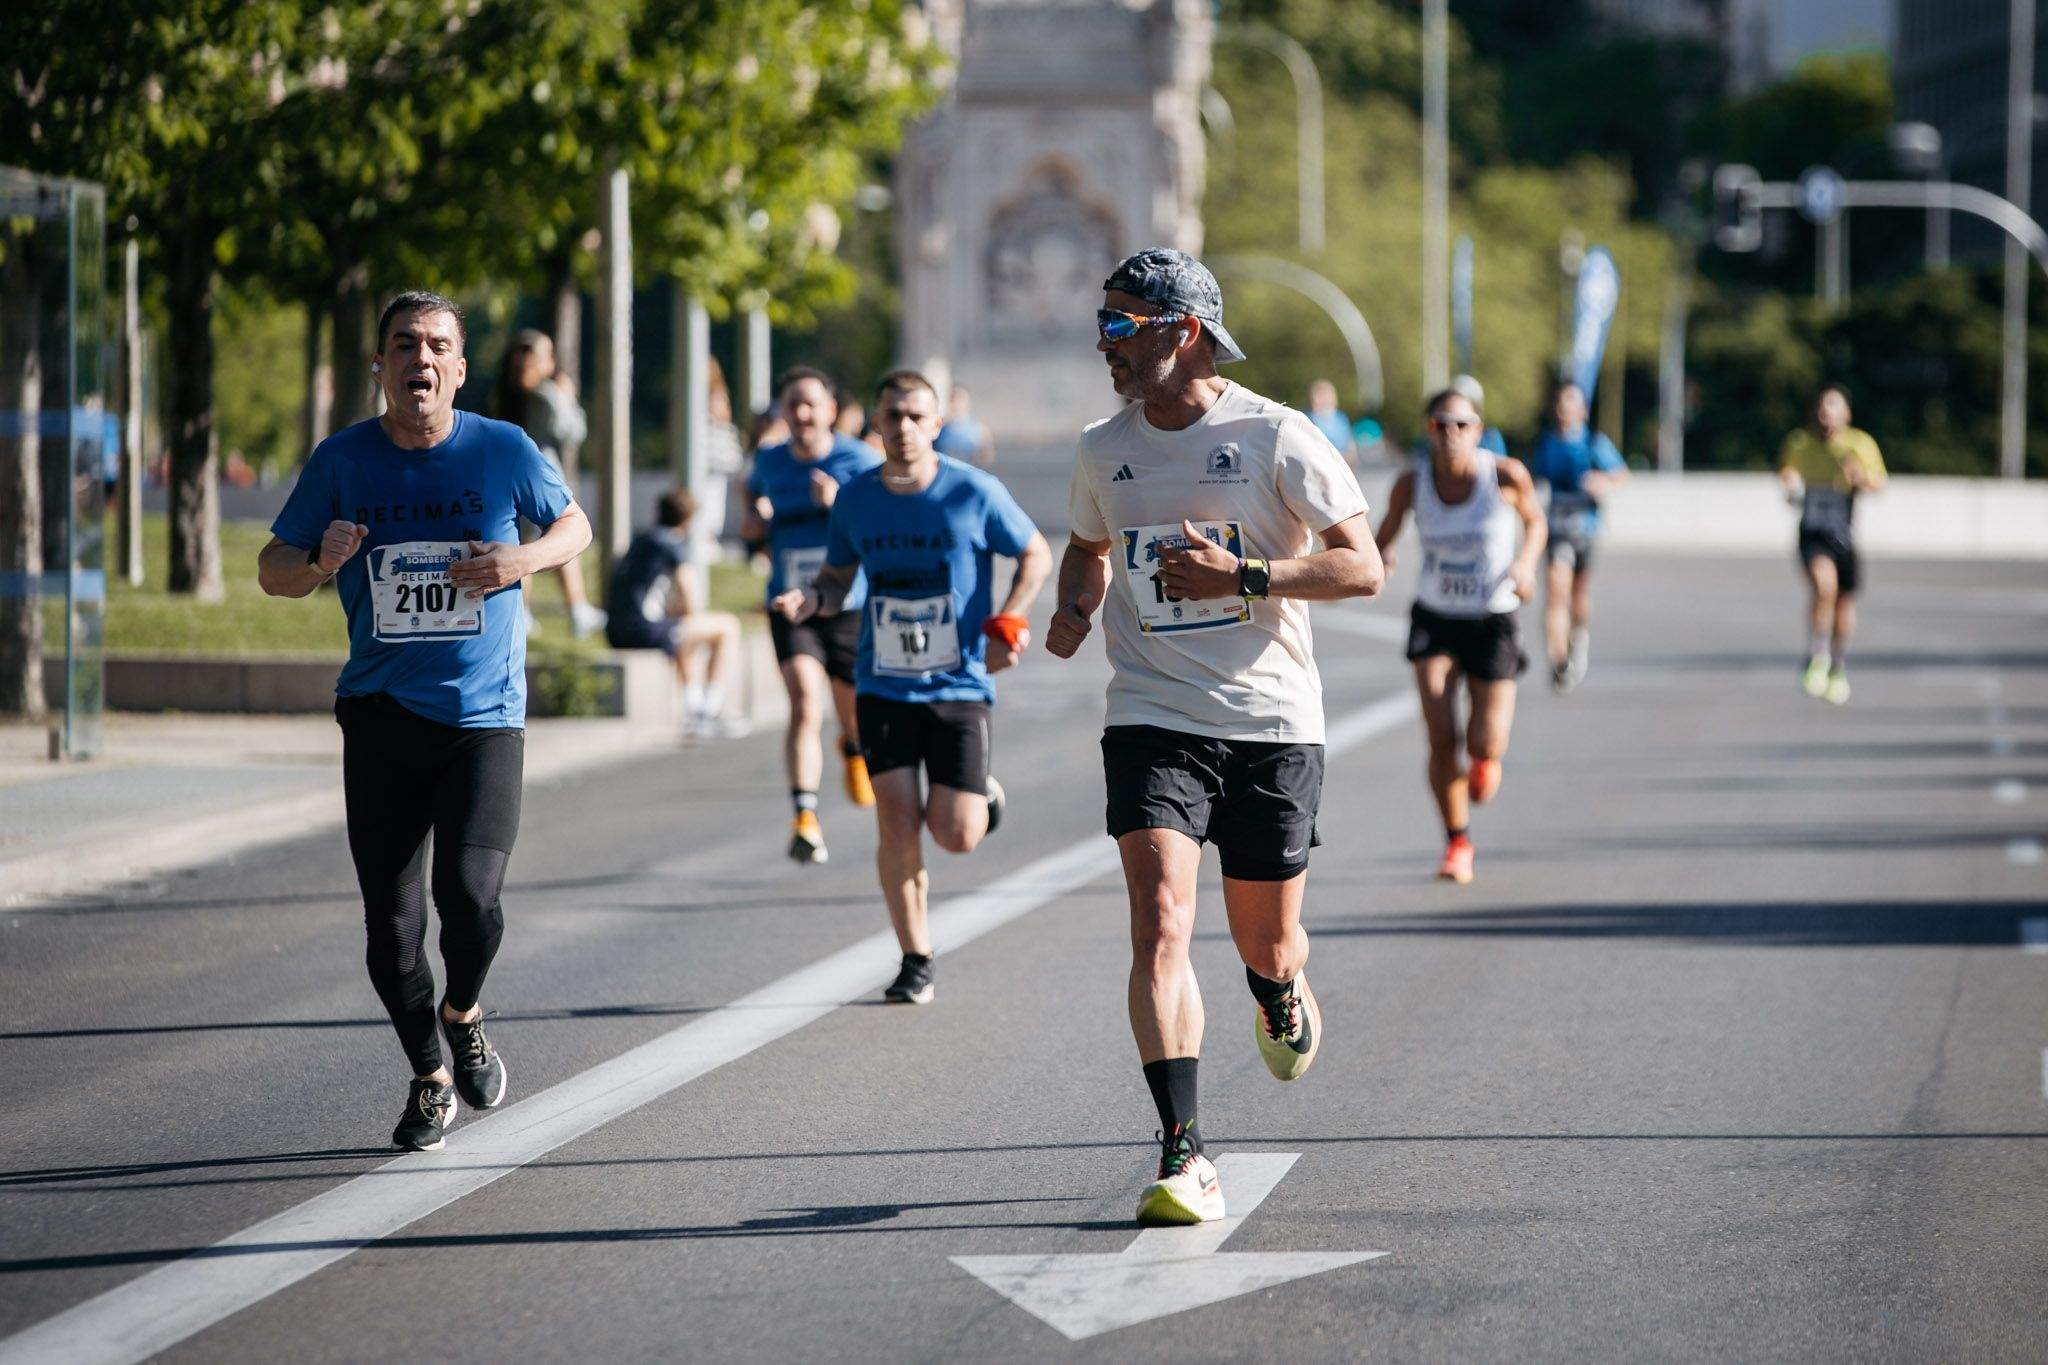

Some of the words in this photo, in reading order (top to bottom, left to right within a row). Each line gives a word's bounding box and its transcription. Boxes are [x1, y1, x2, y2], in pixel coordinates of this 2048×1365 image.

[355, 498, 483, 522] DECIMAS
[1161, 536, 1218, 548] BOMBS
[406, 556, 459, 564] BOMBEROS
[402, 572, 457, 582] DECIMA
[395, 582, 458, 613] 2107
